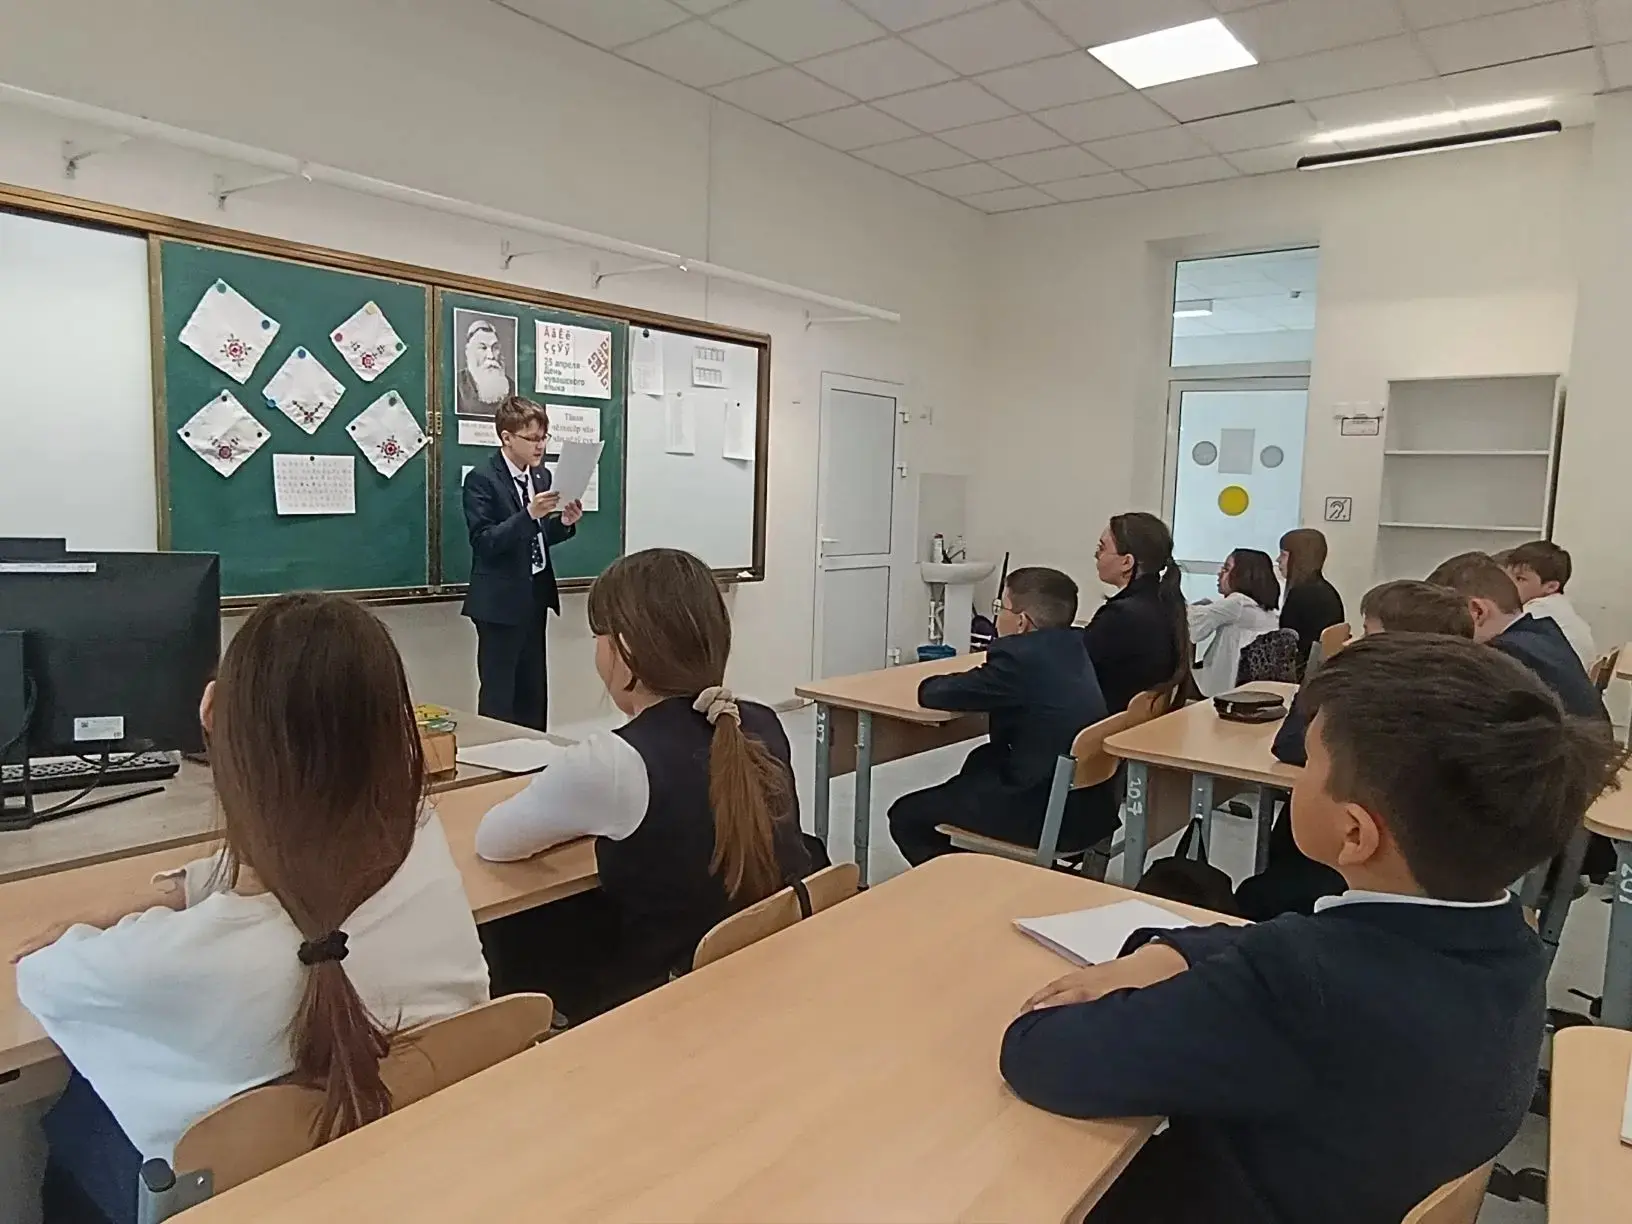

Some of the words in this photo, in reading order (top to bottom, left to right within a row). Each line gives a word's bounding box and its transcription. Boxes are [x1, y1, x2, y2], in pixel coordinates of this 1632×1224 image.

[544, 357, 552, 367] 25
[555, 360, 580, 368] апреля
[544, 367, 562, 376] День
[544, 376, 586, 386] чувашского
[816, 712, 826, 744] 207
